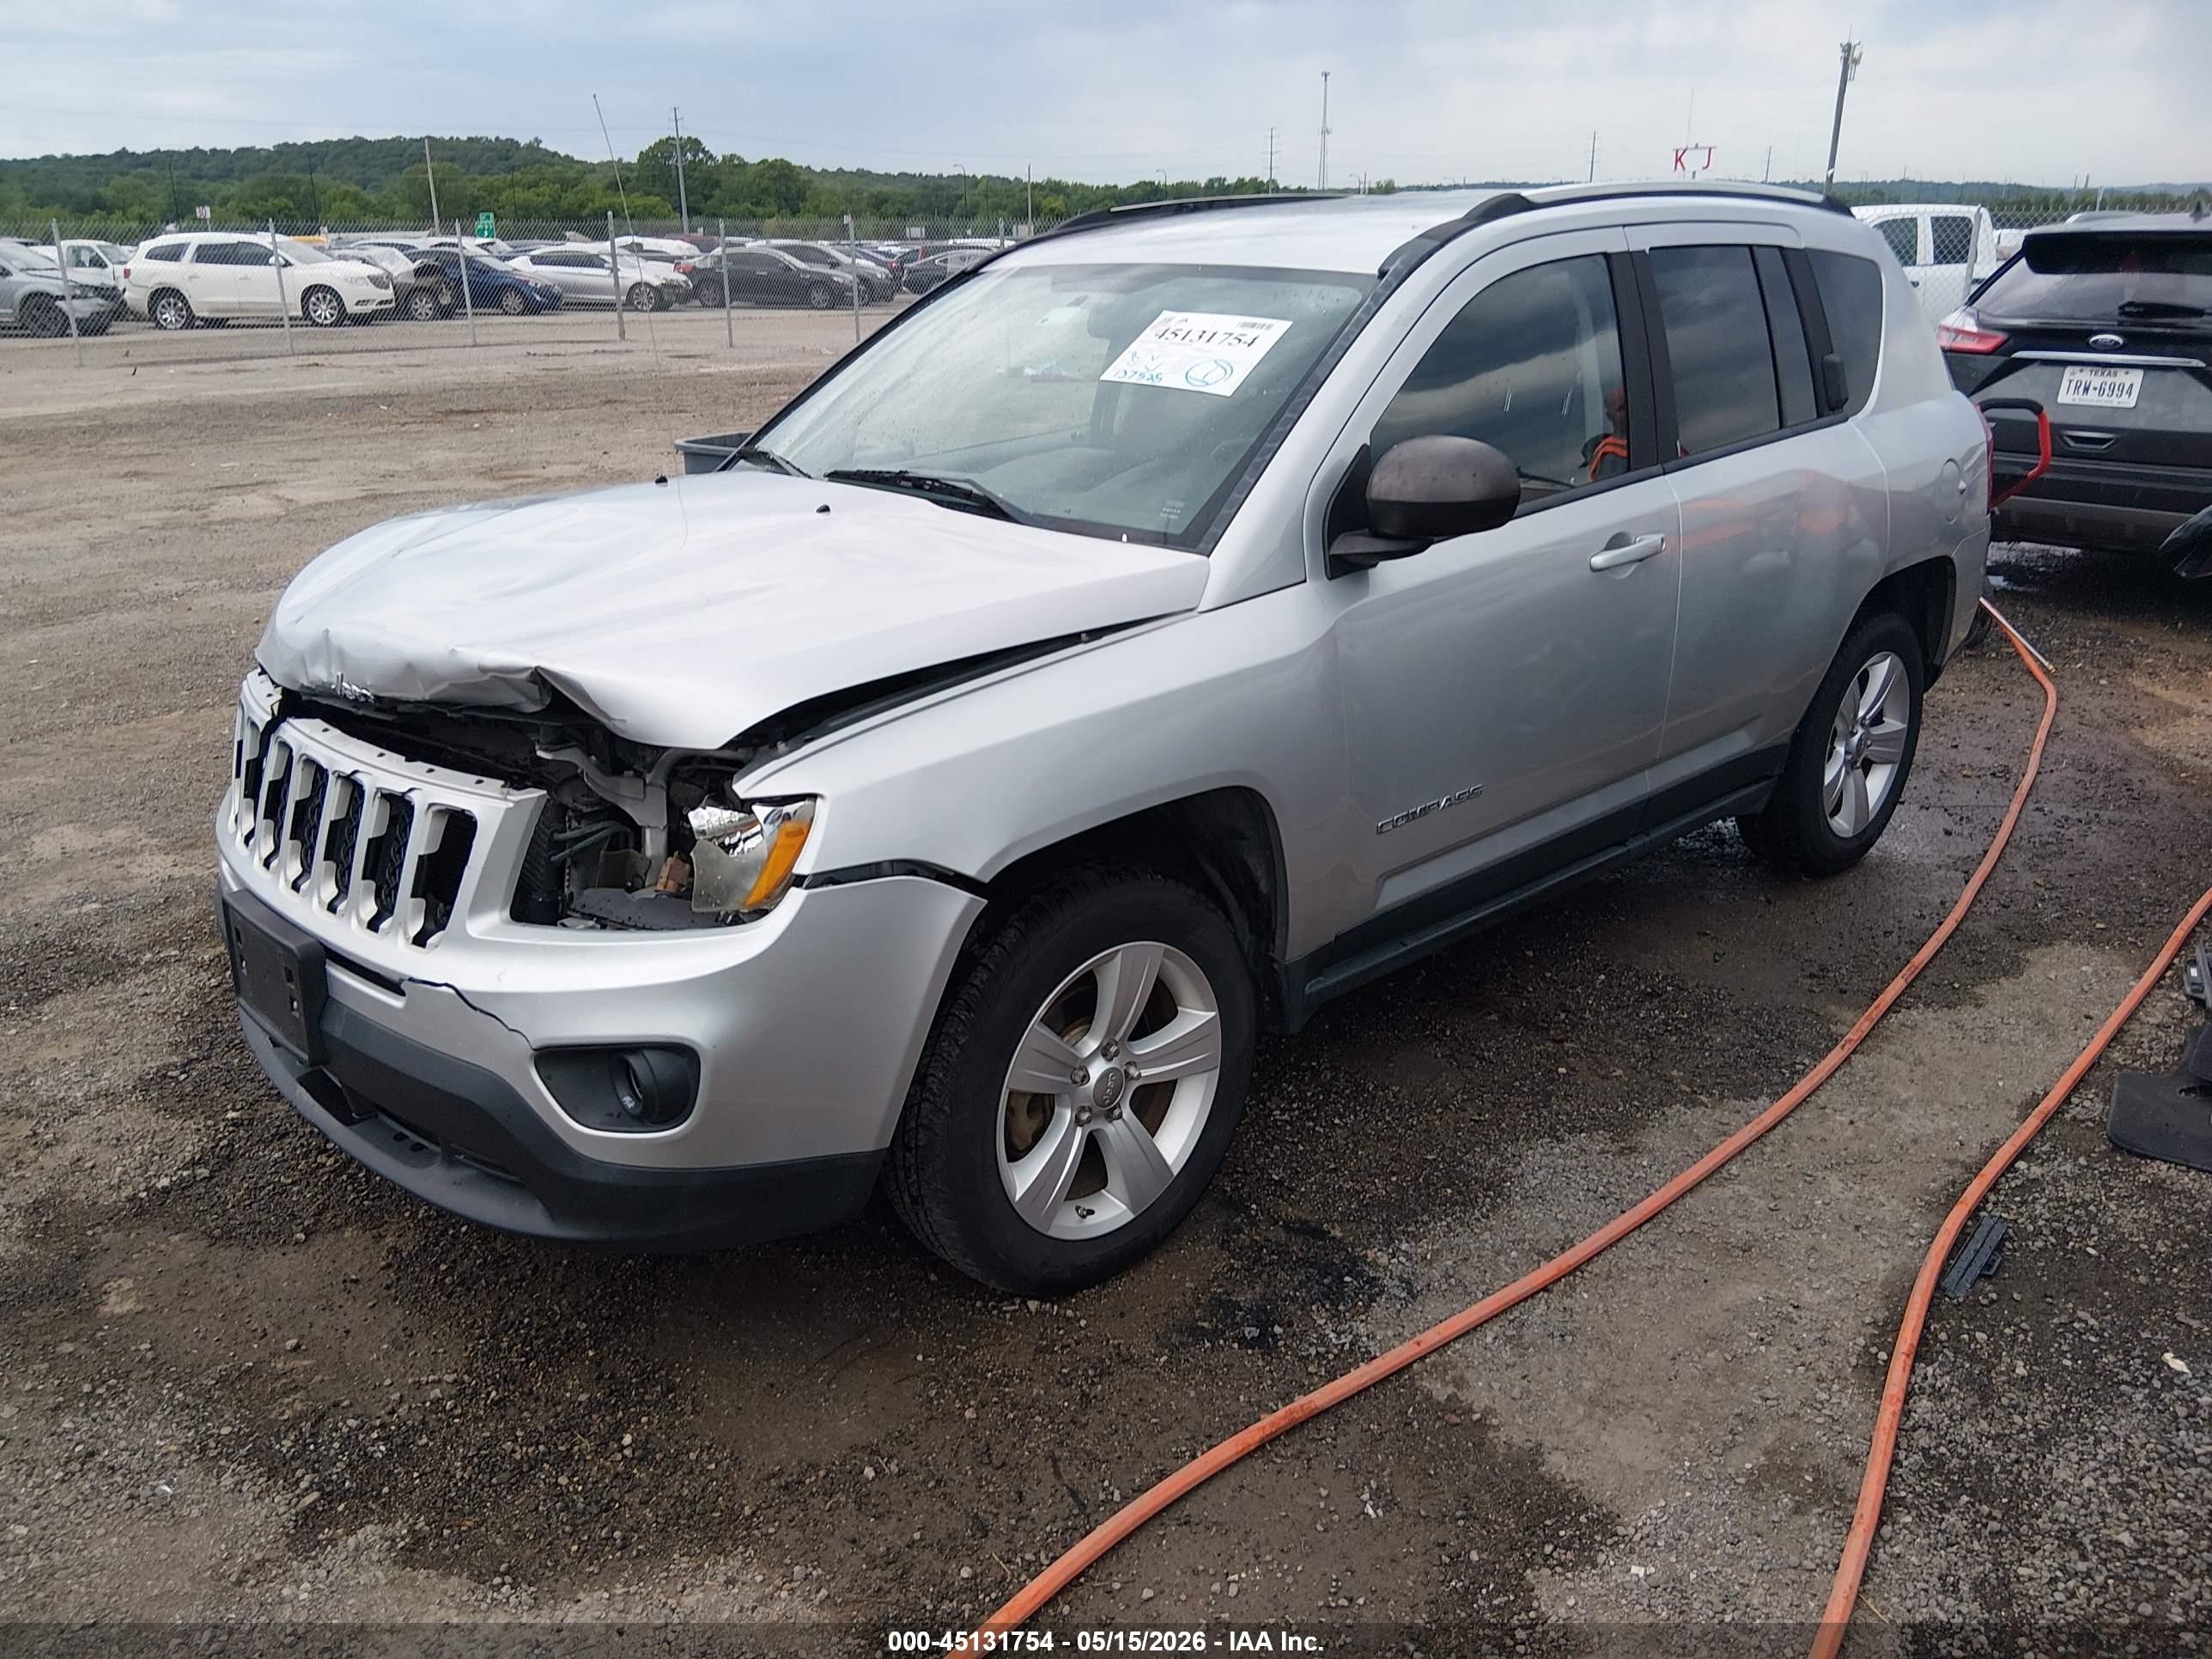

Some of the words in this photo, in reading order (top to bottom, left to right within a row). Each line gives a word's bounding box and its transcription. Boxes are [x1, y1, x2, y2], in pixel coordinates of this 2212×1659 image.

[1154, 328, 1259, 347] 45131754
[2089, 369, 2118, 378] TEXAS
[1376, 783, 1484, 835] COMPASS
